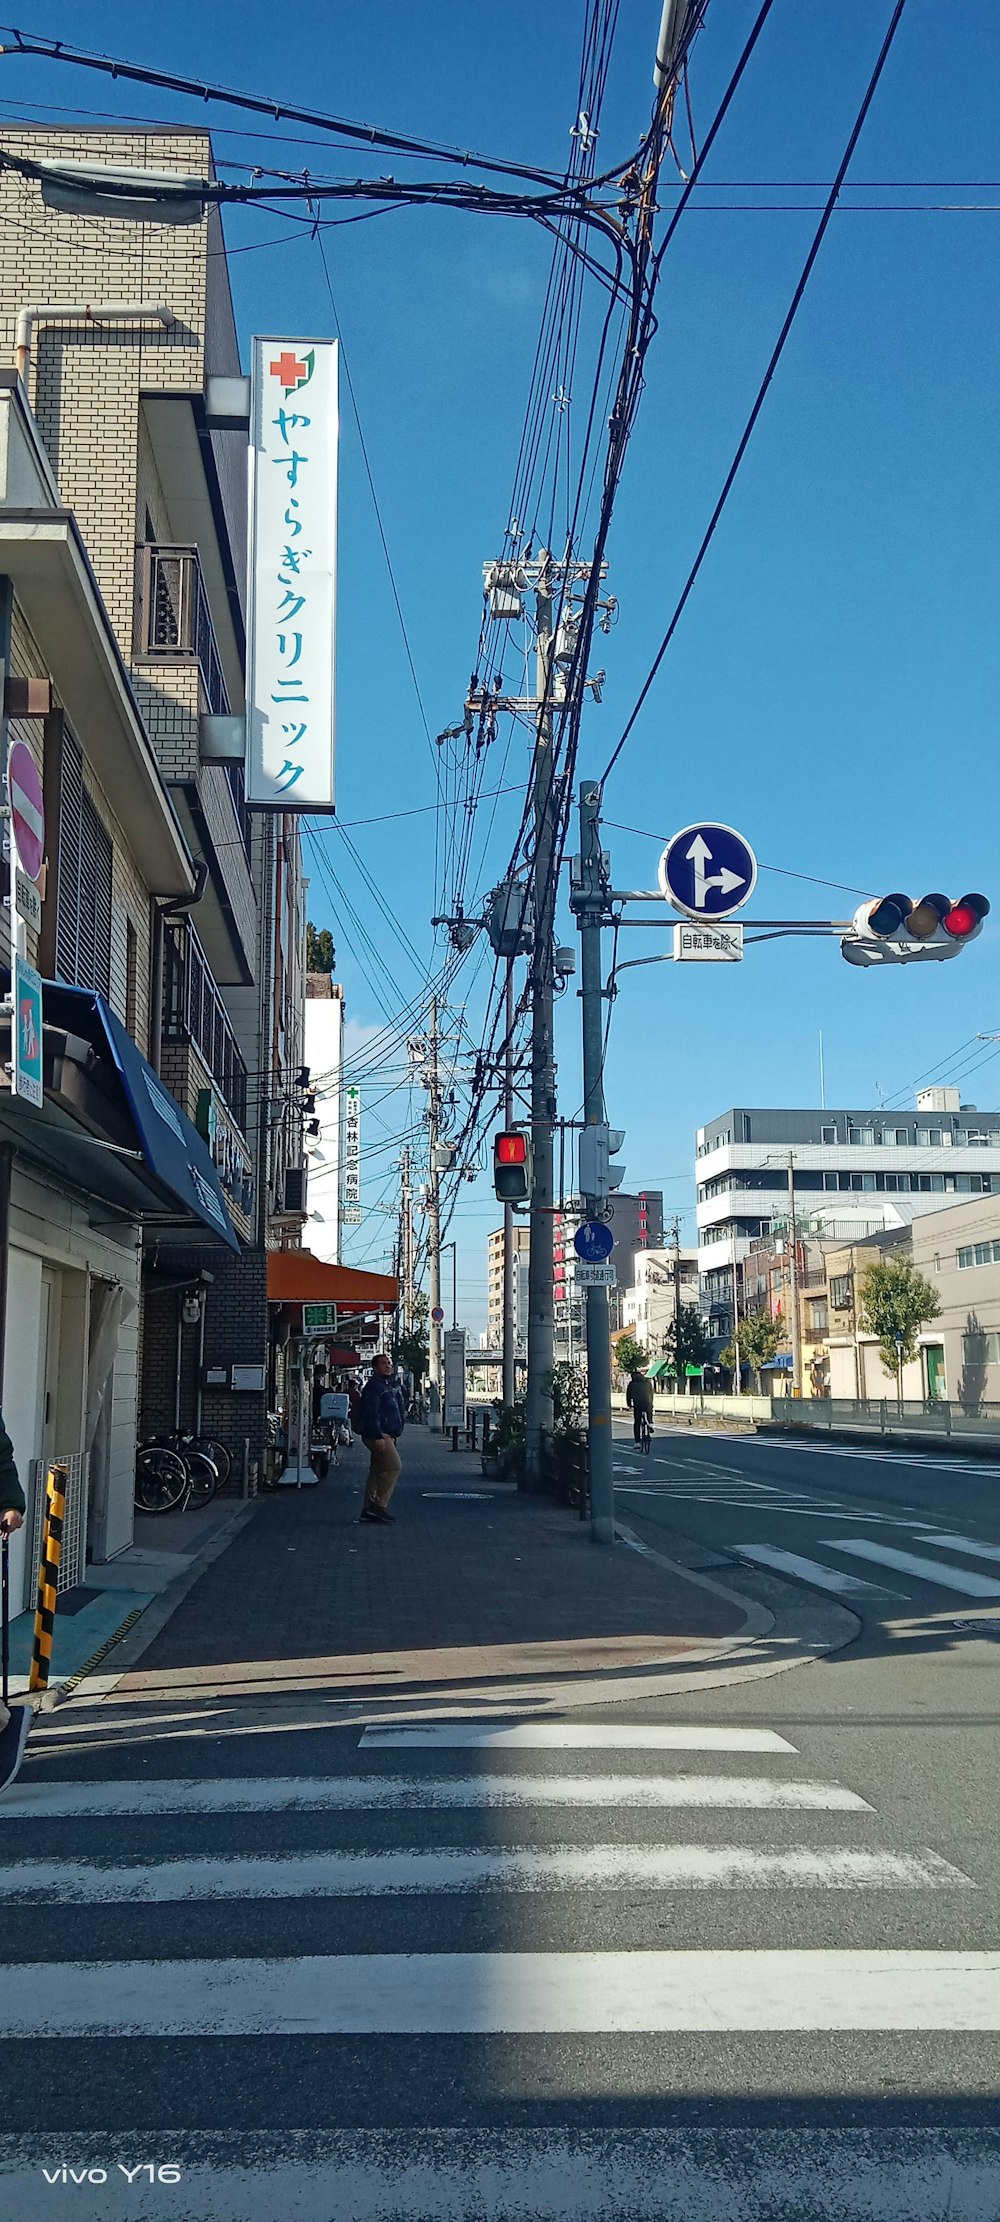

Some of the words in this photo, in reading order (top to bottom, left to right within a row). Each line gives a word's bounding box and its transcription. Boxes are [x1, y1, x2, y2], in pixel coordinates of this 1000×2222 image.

[271, 406, 313, 796] やすらぎクリニック
[682, 933, 739, 950] 自転車を除く
[345, 1117, 359, 1200] 杏林記念病院
